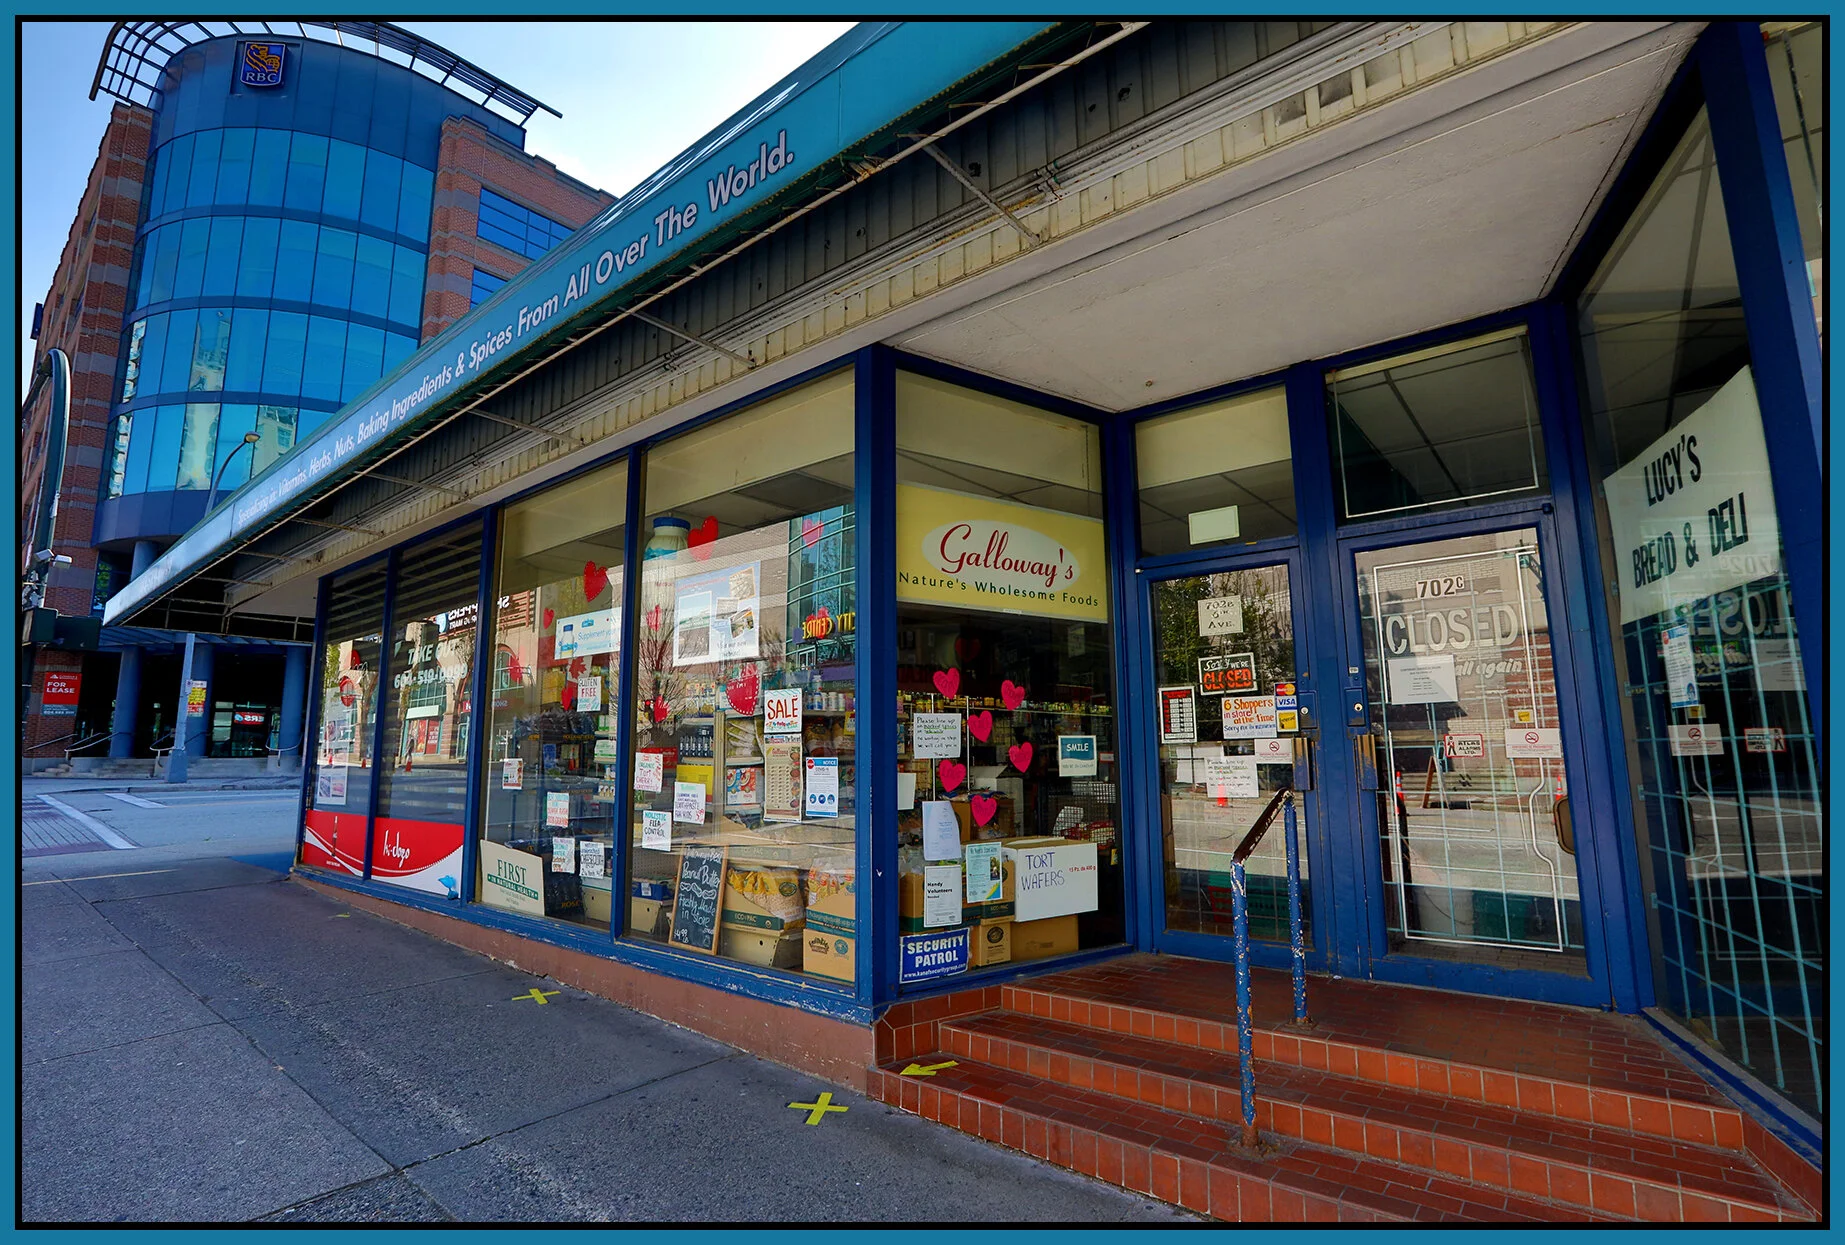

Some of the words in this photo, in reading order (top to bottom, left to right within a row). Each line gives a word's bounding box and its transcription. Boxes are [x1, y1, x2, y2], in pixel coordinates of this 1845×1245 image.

[246, 72, 276, 82] RBC
[334, 435, 354, 460] Nuts,
[357, 408, 389, 445] Baking
[391, 365, 452, 420] Ingredients
[455, 353, 465, 378] &
[469, 322, 512, 372] Spices
[517, 295, 558, 338] From
[563, 265, 590, 308] All
[595, 235, 649, 285] Over
[654, 203, 698, 247] The
[707, 130, 795, 212] World.
[1644, 433, 1701, 507] LUCY'S
[1632, 531, 1677, 588] BREAD
[1684, 522, 1699, 568] &
[1708, 492, 1749, 557] DELI
[940, 524, 1073, 588] Galloway's
[899, 572, 966, 590] Nature's
[975, 581, 1055, 601] Wholesome
[1063, 592, 1098, 607] Foods
[1386, 605, 1519, 655] CLOSED
[408, 644, 434, 665] TAKE
[1455, 660, 1474, 677] all
[1476, 658, 1522, 678] again
[579, 678, 598, 687] GLUTEN
[1204, 668, 1253, 690] CLOSED
[581, 687, 596, 697] FREE
[768, 696, 798, 720] SALE
[1224, 699, 1232, 711] 6
[1234, 698, 1274, 714] Shoppers
[1232, 710, 1252, 718] store
[1256, 714, 1274, 722] time
[1224, 724, 1239, 733] Sorry
[1066, 743, 1089, 752] SMILE
[644, 827, 665, 837] CONTROL
[1025, 852, 1056, 870] TORT
[497, 859, 526, 886] FIRST
[1021, 869, 1065, 891] WAFERS
[497, 877, 517, 892] NATURAL
[517, 884, 535, 898] HEALTH
[682, 908, 689, 919] in
[907, 935, 964, 955] SECURITY
[915, 950, 958, 968] PATROL
